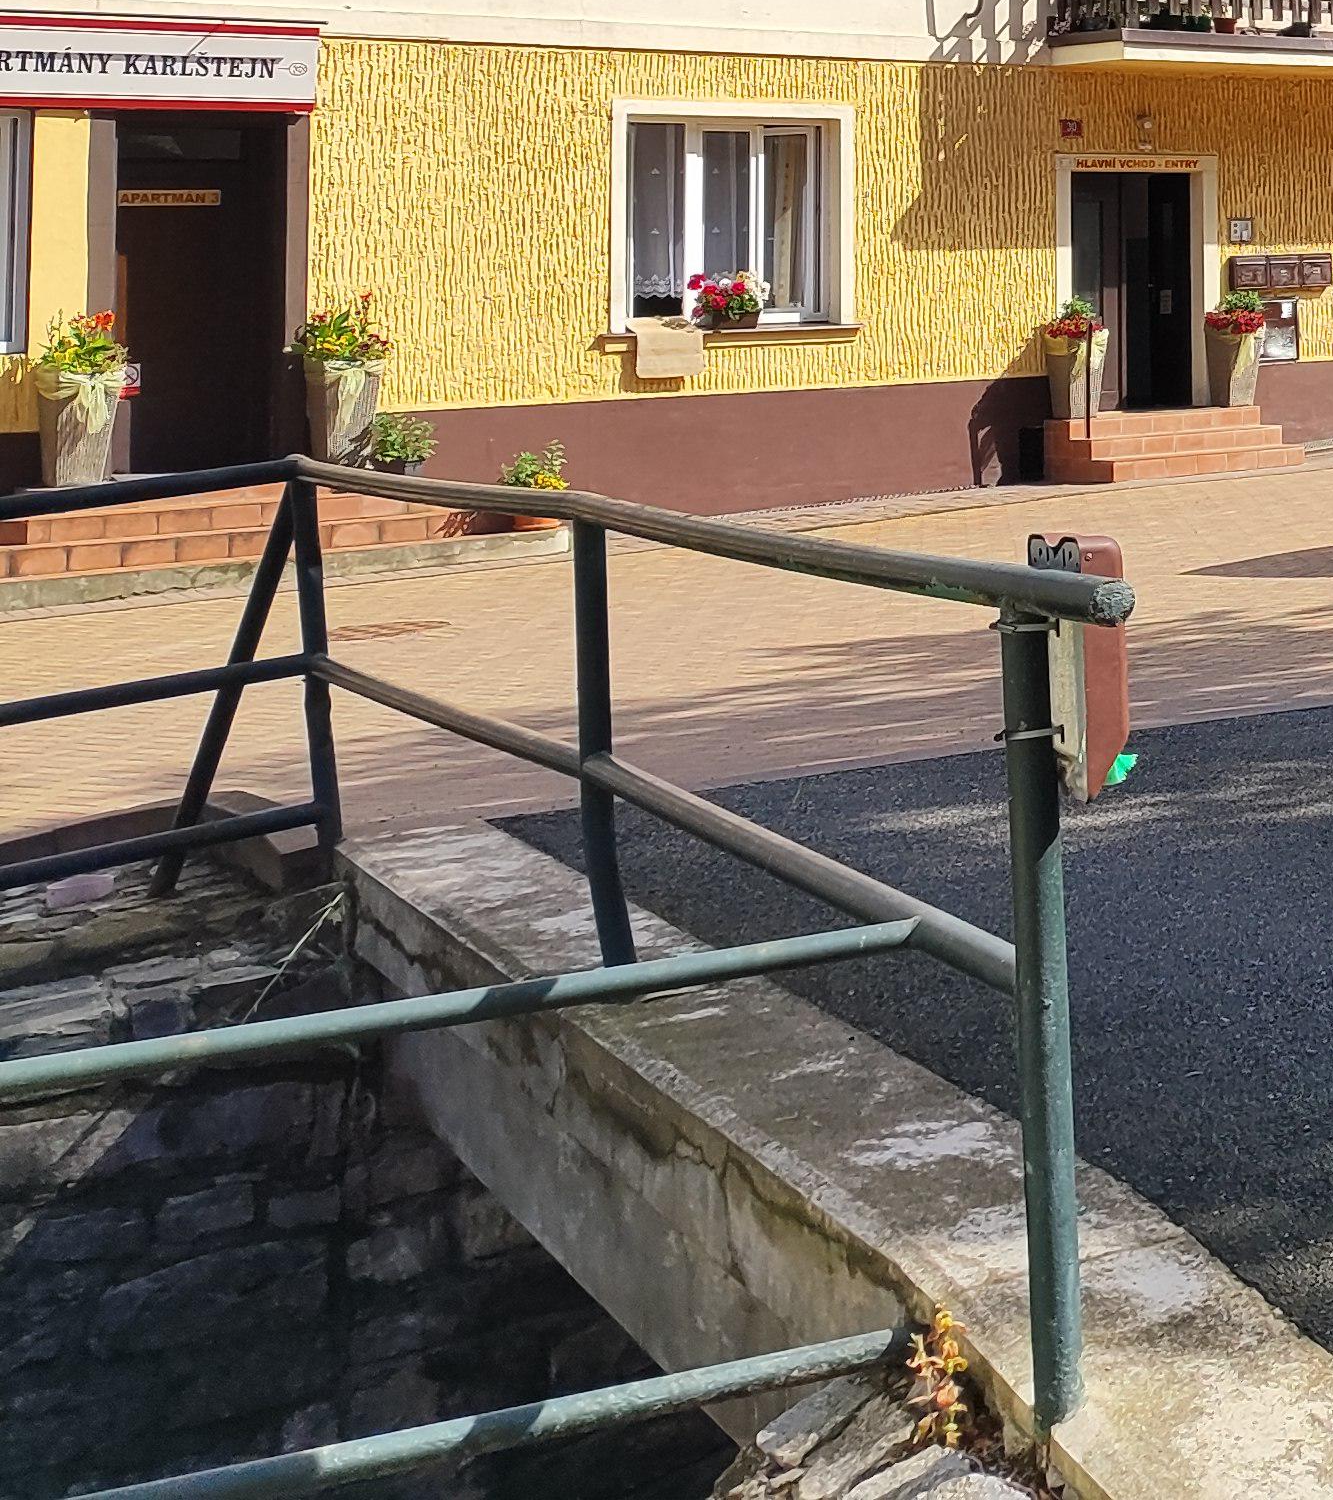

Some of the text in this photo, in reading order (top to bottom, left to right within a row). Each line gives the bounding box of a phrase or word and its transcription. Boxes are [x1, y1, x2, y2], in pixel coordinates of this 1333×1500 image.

[122, 51, 278, 79] KARLŠTEJN
[1076, 157, 1116, 169] HLAVNÍ
[1119, 159, 1156, 169] VCHOD
[1165, 159, 1199, 169] ENTRY
